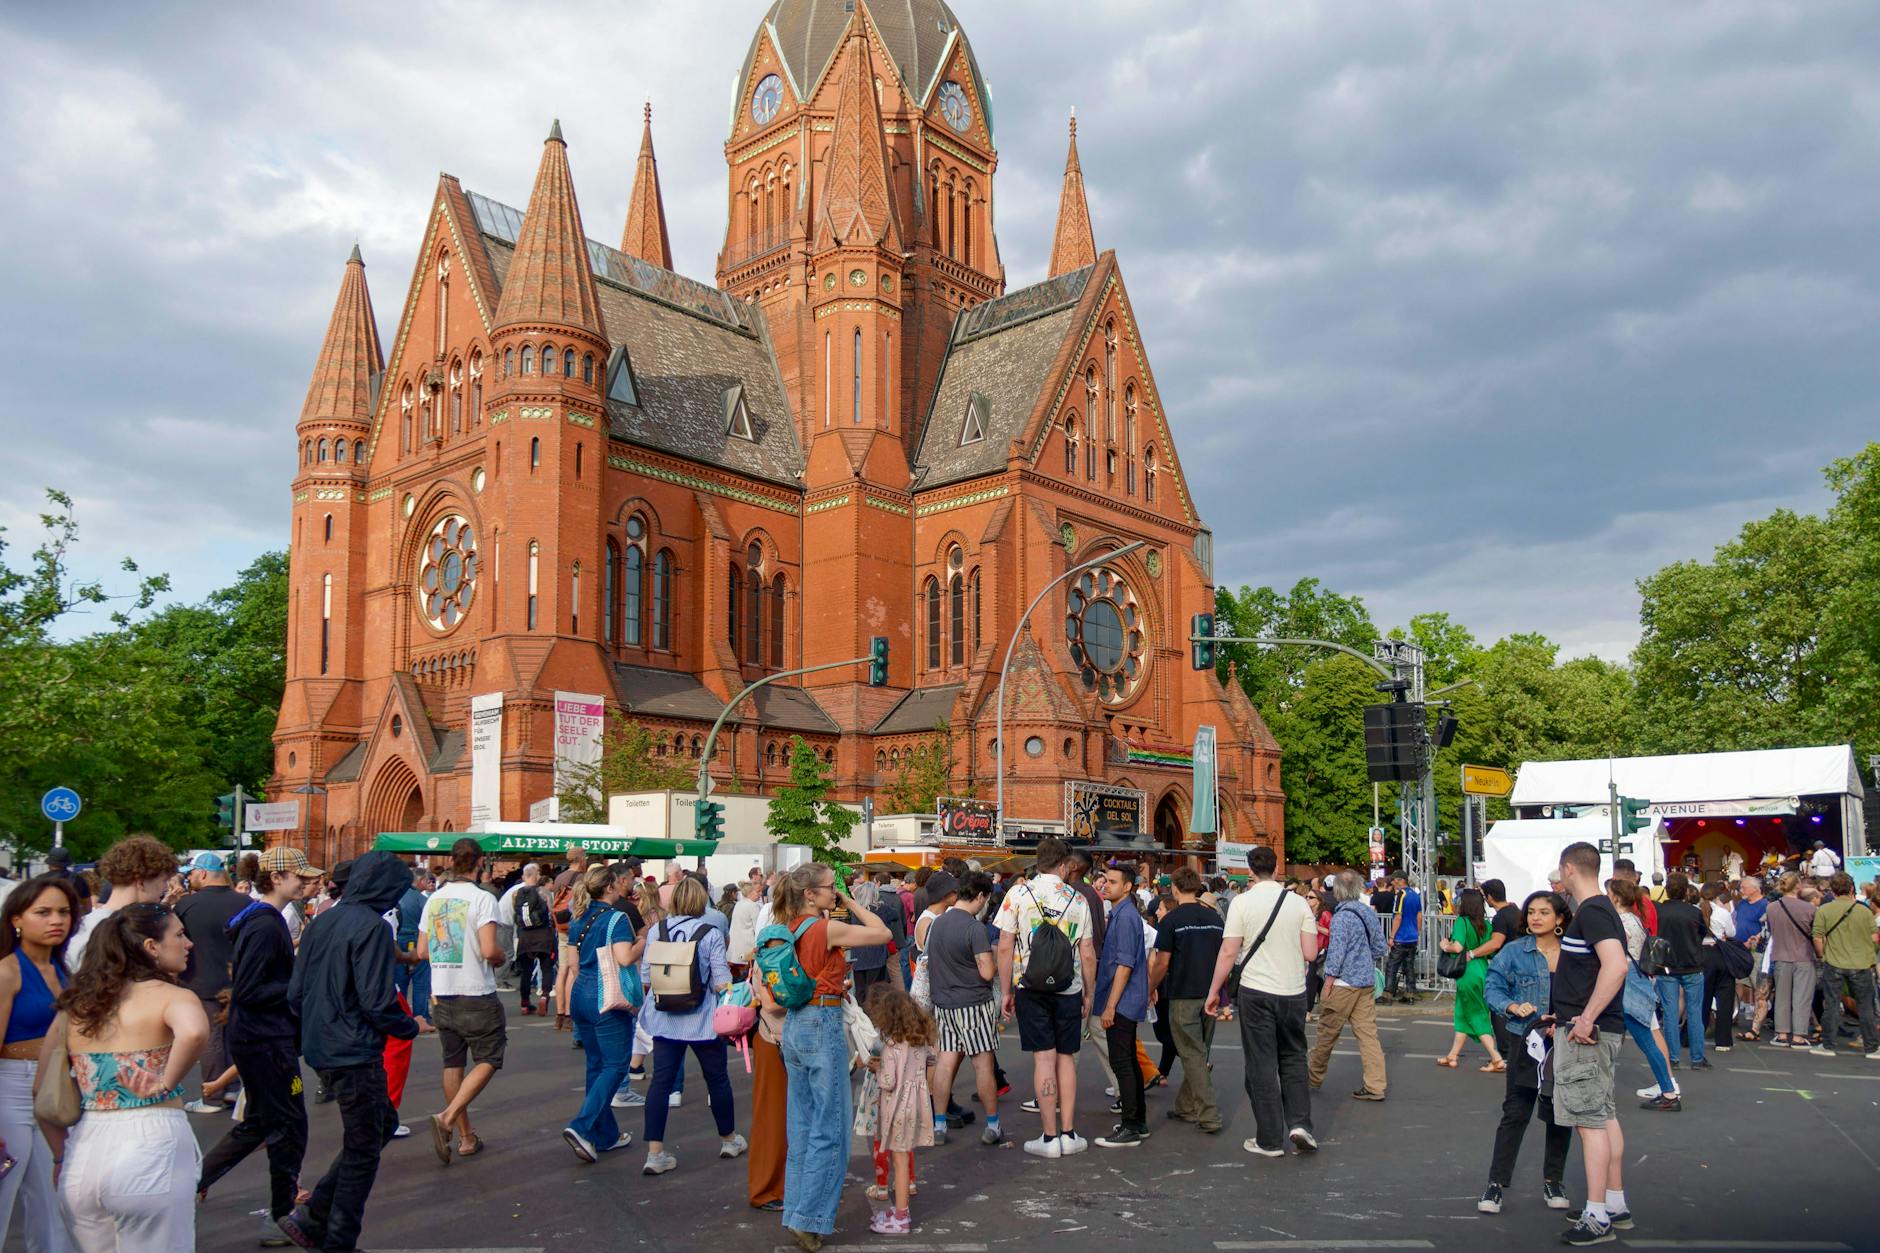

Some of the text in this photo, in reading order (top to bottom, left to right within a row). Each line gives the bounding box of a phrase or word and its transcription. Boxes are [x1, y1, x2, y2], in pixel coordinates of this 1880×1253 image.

[558, 702, 587, 713] LIEBE
[559, 713, 600, 726] TUT DER
[559, 724, 587, 735] SEELE
[558, 735, 580, 746] GUT.
[625, 799, 650, 808] Toiletten
[675, 798, 697, 807] Toilet
[1103, 798, 1137, 810] COCKTAILS
[1653, 804, 1706, 815] AVENUE
[953, 810, 990, 830] Crêpes
[1107, 810, 1134, 822] DEL SOL
[501, 837, 633, 851] ALPEN STOFF
